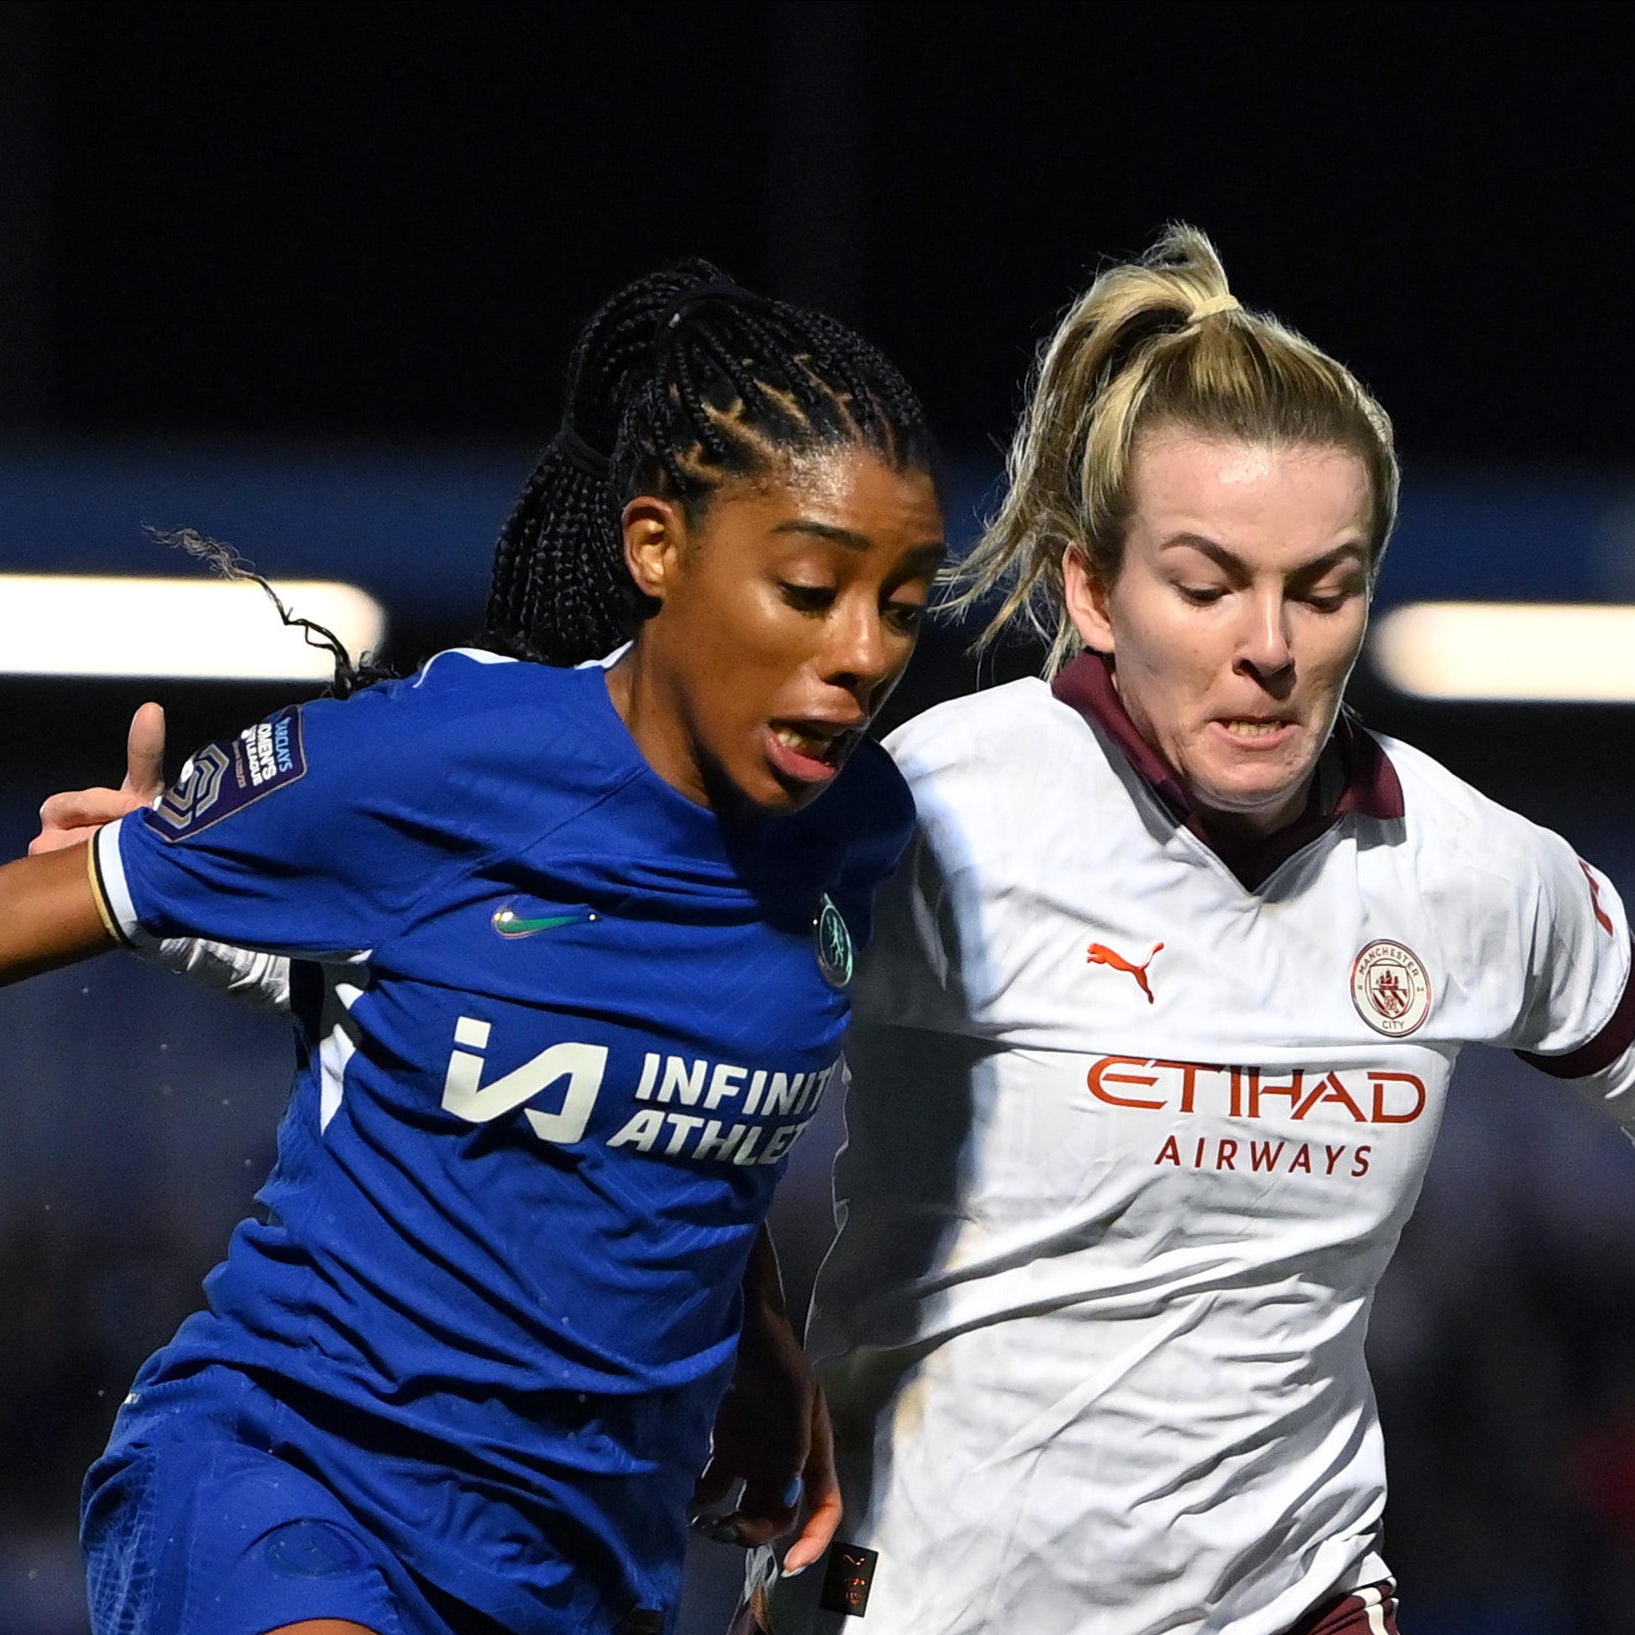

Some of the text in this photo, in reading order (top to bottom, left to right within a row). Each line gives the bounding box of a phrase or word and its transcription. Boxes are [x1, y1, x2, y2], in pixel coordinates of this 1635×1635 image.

[257, 723, 277, 780] OMEN'S
[1359, 946, 1420, 976] MANCHESTER
[1382, 1020, 1405, 1029] CITY
[1087, 1055, 1427, 1124] ETIHAD
[1154, 1135, 1372, 1177] AIRWAYS
